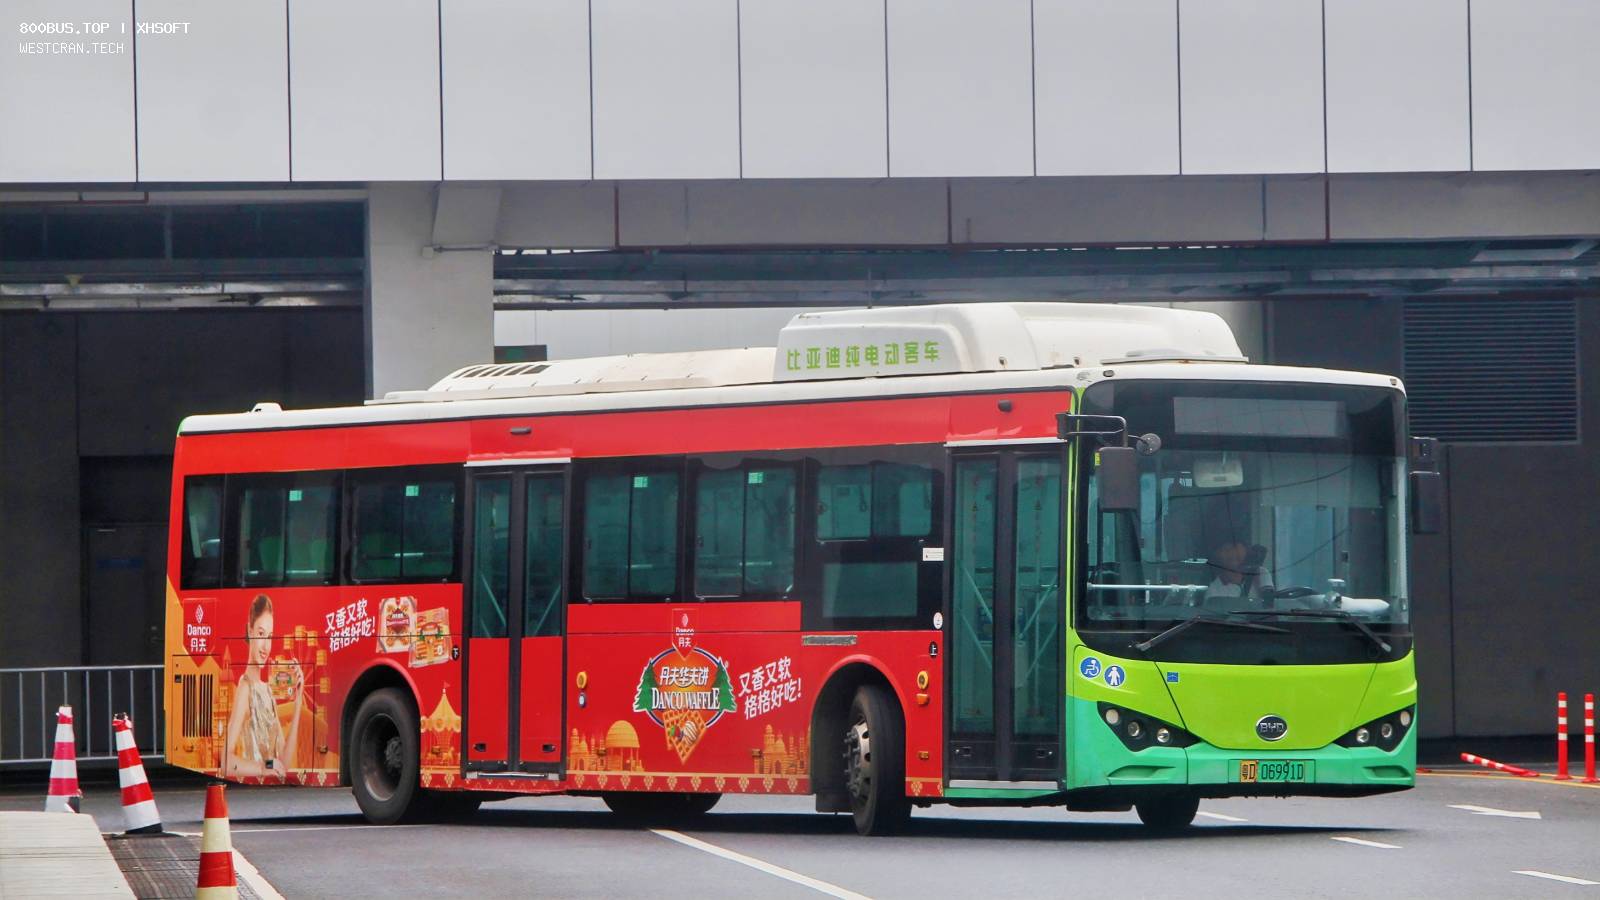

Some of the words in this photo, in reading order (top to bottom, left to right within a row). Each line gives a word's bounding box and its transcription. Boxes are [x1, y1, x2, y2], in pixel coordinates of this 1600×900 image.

[786, 340, 940, 371] 比亚迪纯电动客车
[324, 597, 368, 634] 又香又软
[187, 623, 211, 636] Danco
[190, 637, 207, 652] 丹夫
[660, 666, 709, 687] 丹夫华夫饼
[738, 656, 791, 697] 又香又软
[651, 687, 683, 710] DANCO
[684, 687, 721, 710] WAFFLE
[744, 677, 802, 720] 格格好吃!
[1259, 722, 1284, 733] BYD
[1261, 763, 1304, 780] 06991D
